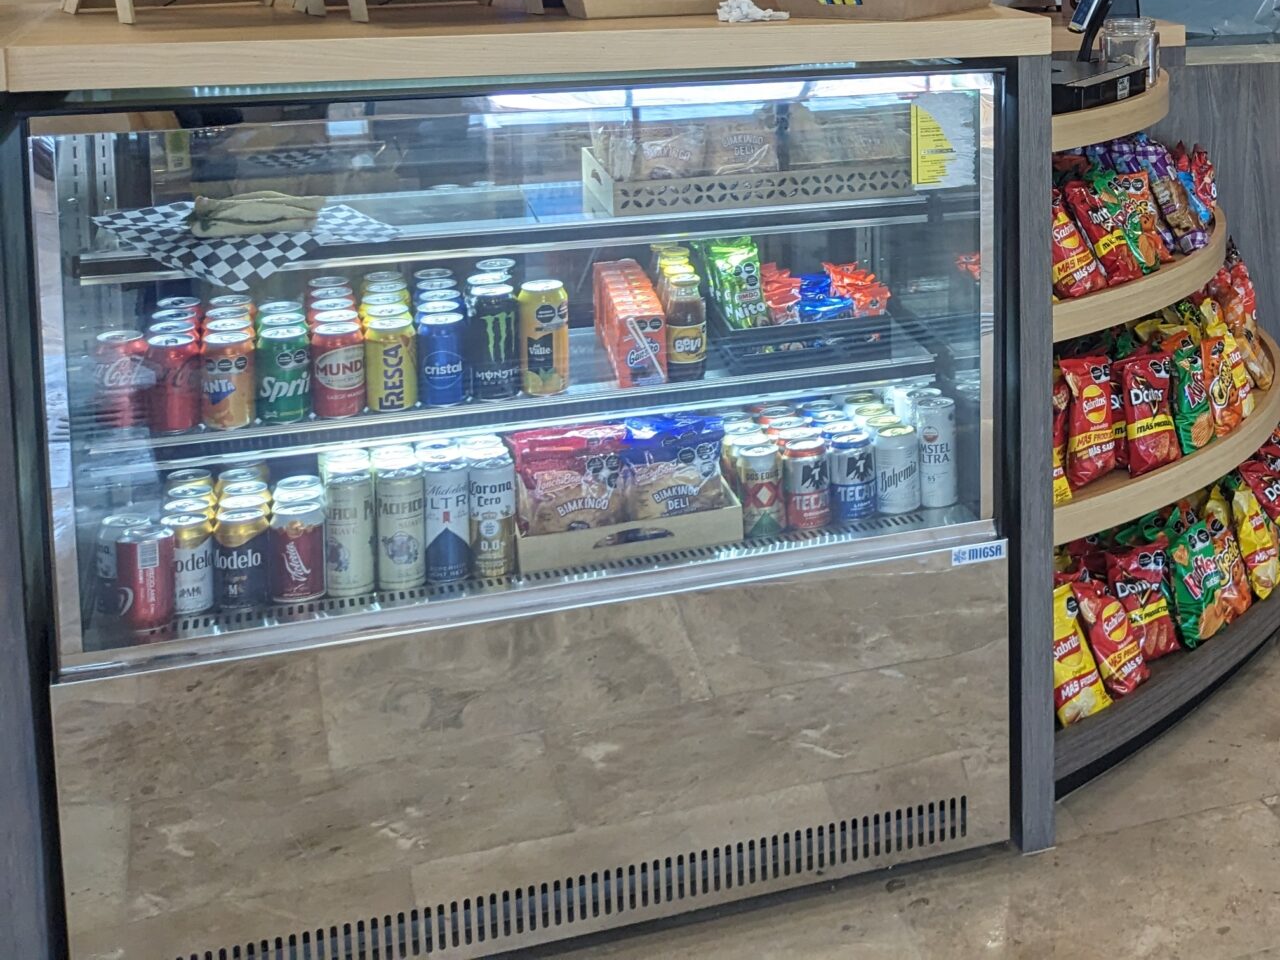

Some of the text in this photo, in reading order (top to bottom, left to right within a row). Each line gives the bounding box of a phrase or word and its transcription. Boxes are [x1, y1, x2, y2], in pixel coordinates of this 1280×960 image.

[735, 302, 766, 321] Nito
[528, 346, 552, 355] Valle
[628, 342, 660, 365] Gansto
[316, 359, 363, 377] MUND
[425, 360, 463, 376] cristal
[379, 344, 403, 411] FRESCA
[880, 460, 917, 492] Bohemia
[470, 480, 512, 497] Corona
[652, 485, 700, 503] BIMKINGO
[477, 496, 501, 508] Cero
[556, 497, 609, 518] BIMKINGO
[667, 497, 690, 511] DELI
[968, 543, 1002, 561] MIGSA
[1116, 580, 1160, 599] Dorits
